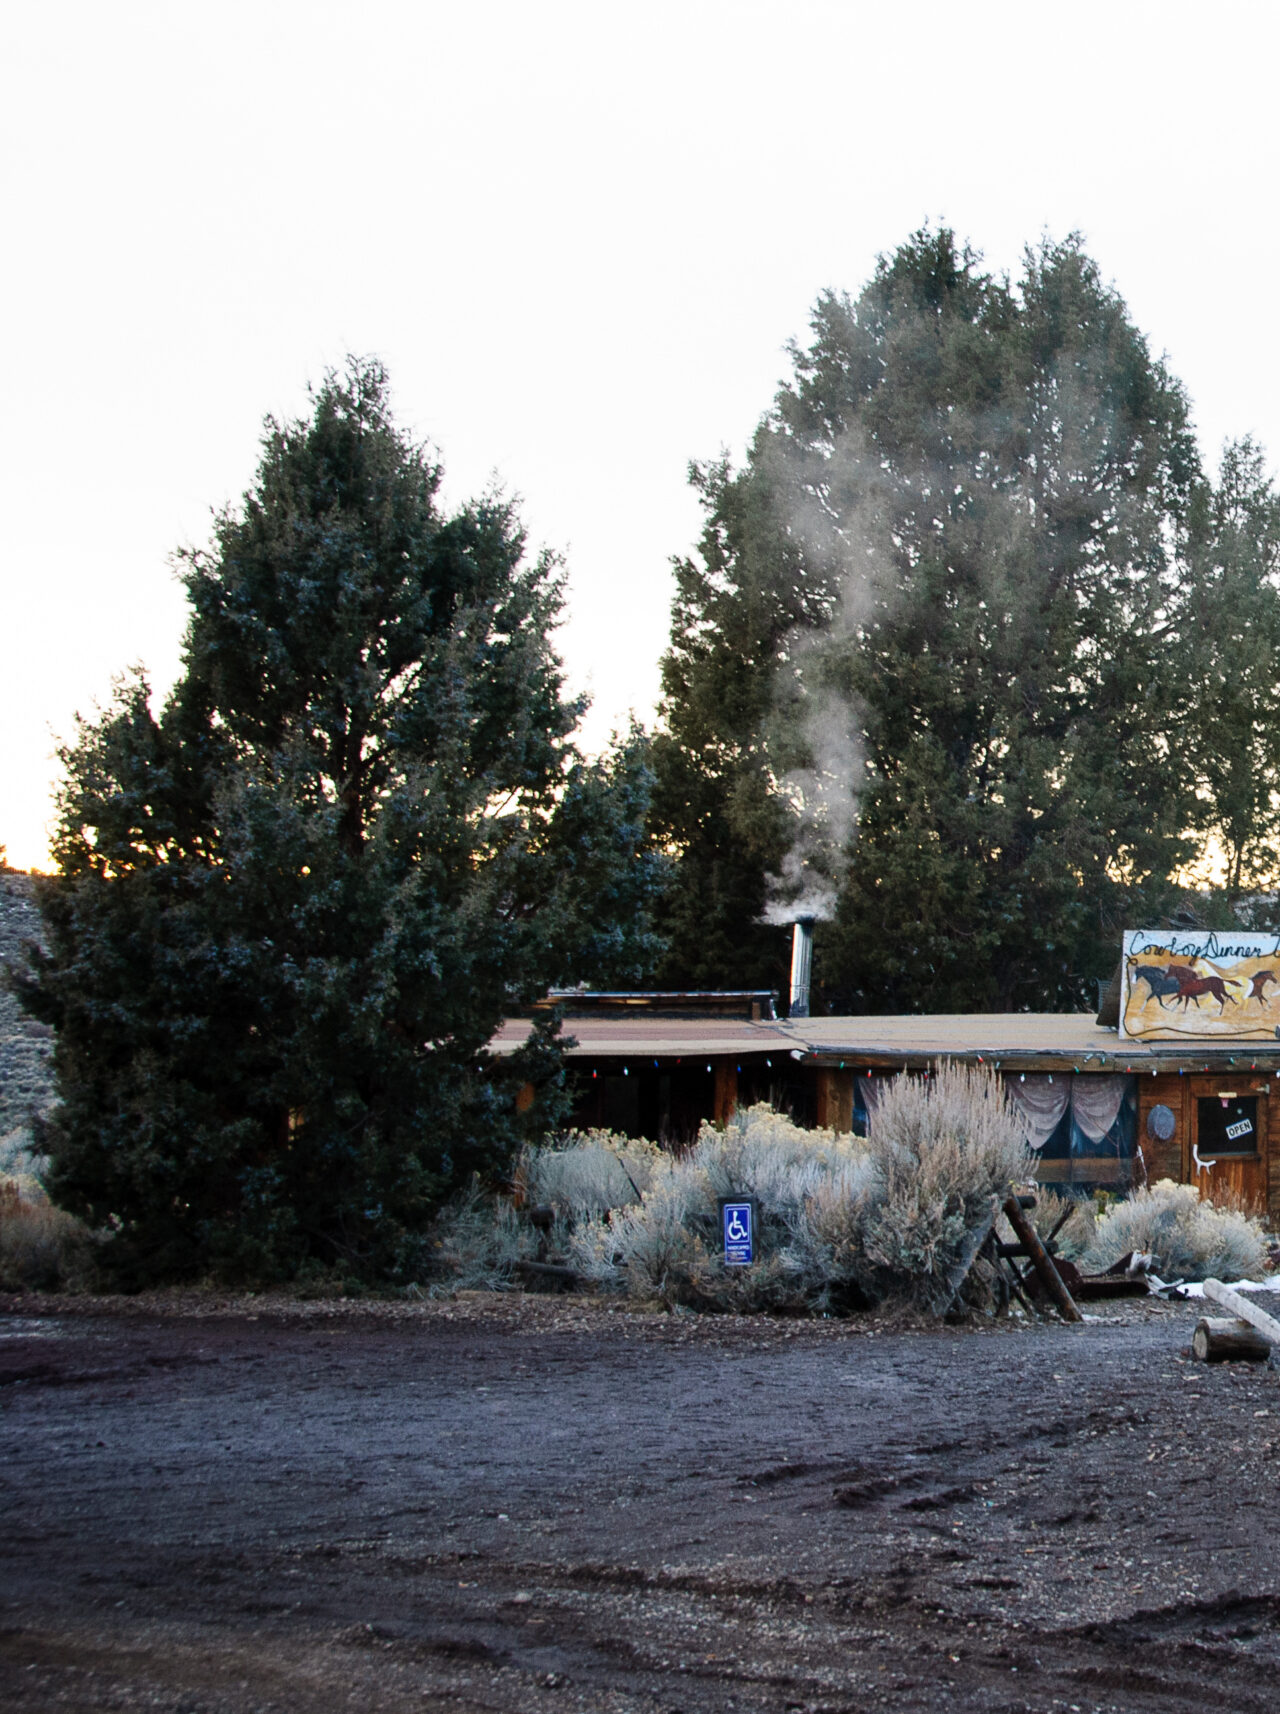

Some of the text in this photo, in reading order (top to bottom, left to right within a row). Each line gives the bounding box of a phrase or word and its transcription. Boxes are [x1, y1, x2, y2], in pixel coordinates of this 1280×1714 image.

[1130, 931, 1199, 965] Cowboy
[1200, 932, 1263, 958] Dinner
[1228, 1120, 1251, 1137] OPEN
